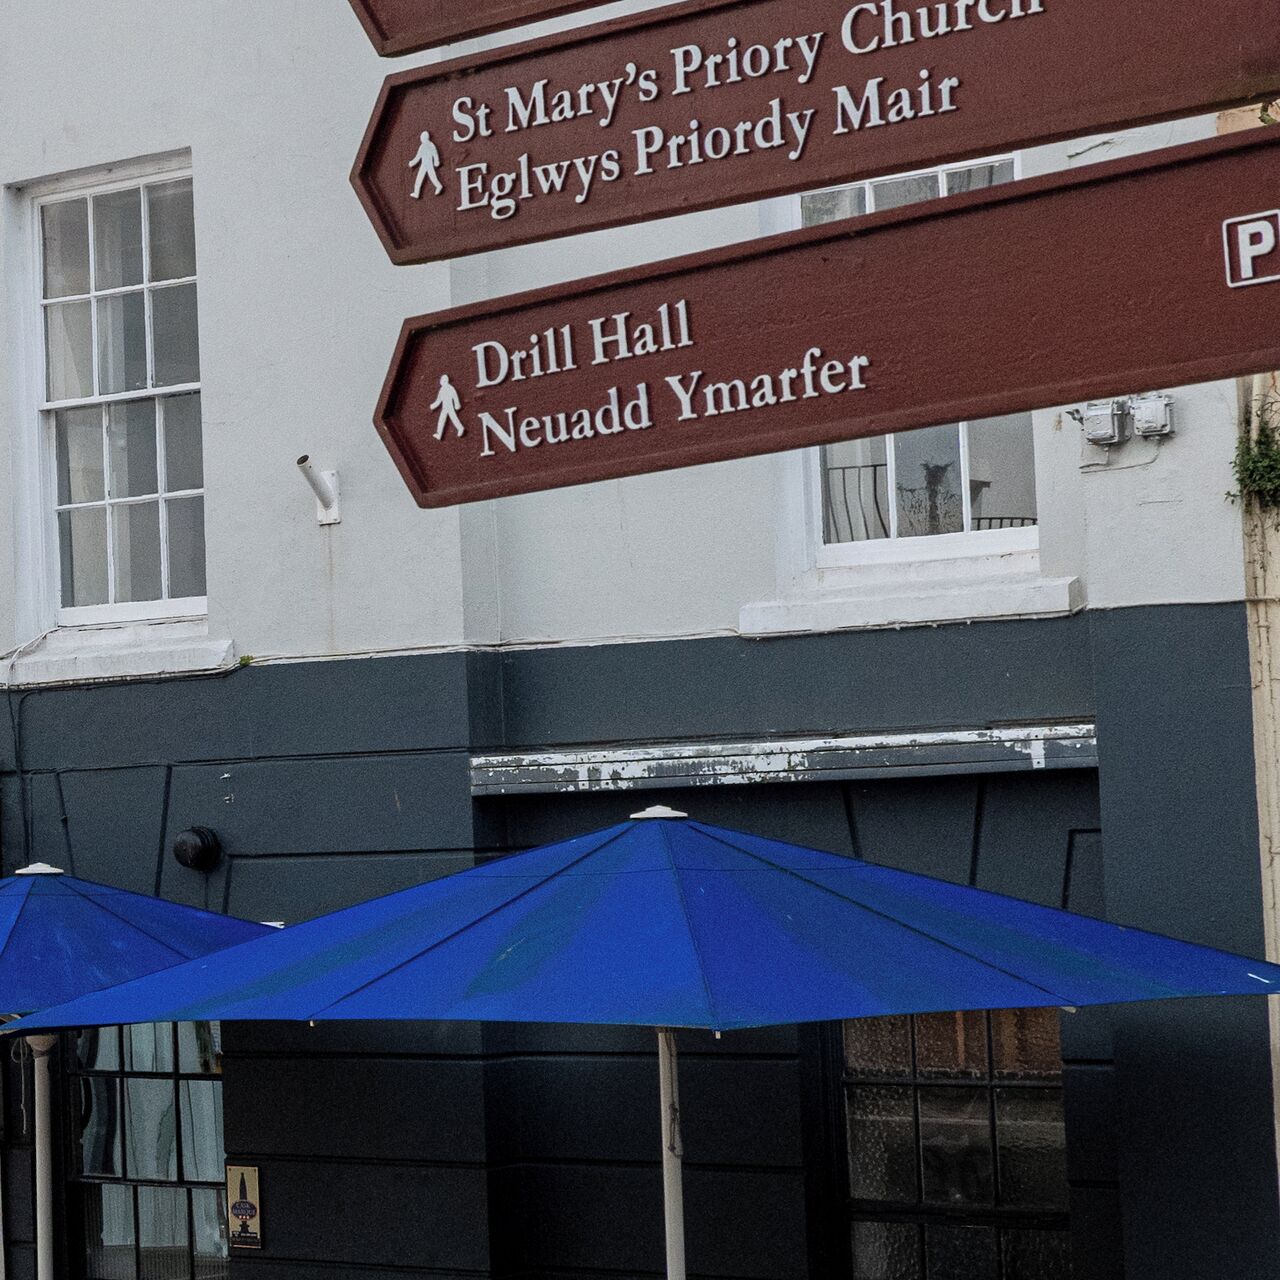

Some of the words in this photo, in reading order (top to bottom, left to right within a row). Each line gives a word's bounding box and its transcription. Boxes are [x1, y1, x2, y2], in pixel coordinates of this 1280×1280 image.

[452, 97, 492, 143] St
[504, 63, 658, 133] Mary's
[670, 30, 824, 96] Priory
[456, 149, 621, 220] Eglwys
[633, 99, 815, 176] Priordy
[832, 69, 961, 135] Mair
[1237, 220, 1275, 279] P
[472, 323, 578, 389] Drill
[588, 299, 694, 366] Hall
[478, 382, 652, 458] Neuadd
[665, 346, 870, 421] Ymarfer
